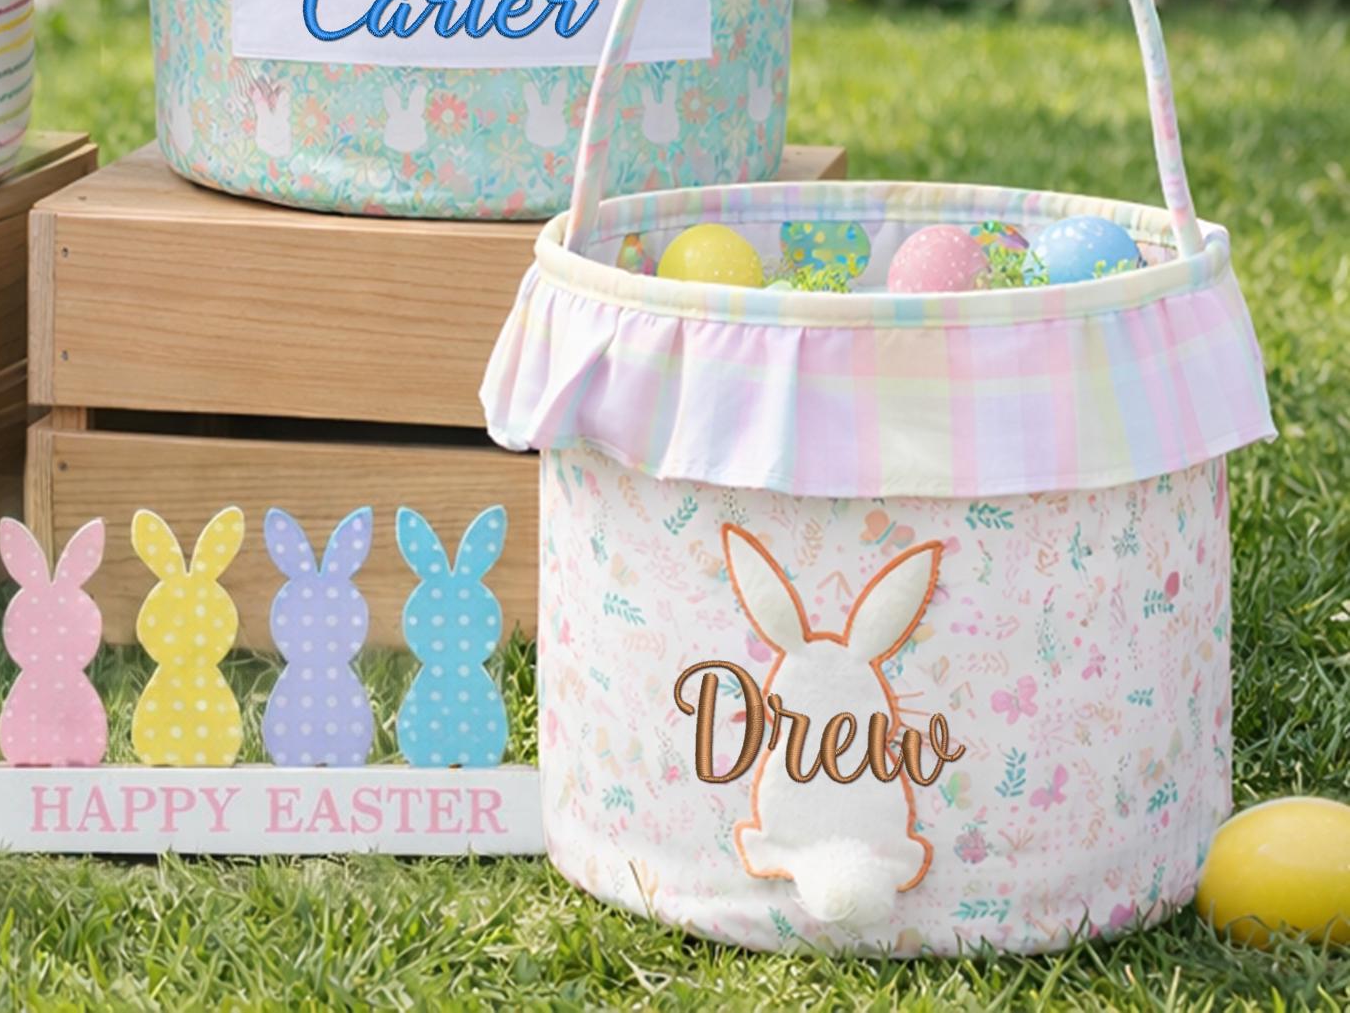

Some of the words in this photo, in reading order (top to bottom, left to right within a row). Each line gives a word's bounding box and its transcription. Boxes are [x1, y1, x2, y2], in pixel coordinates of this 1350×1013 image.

[673, 659, 966, 787] Drew
[29, 785, 241, 834] HAPPY
[264, 786, 508, 835] EASTER
